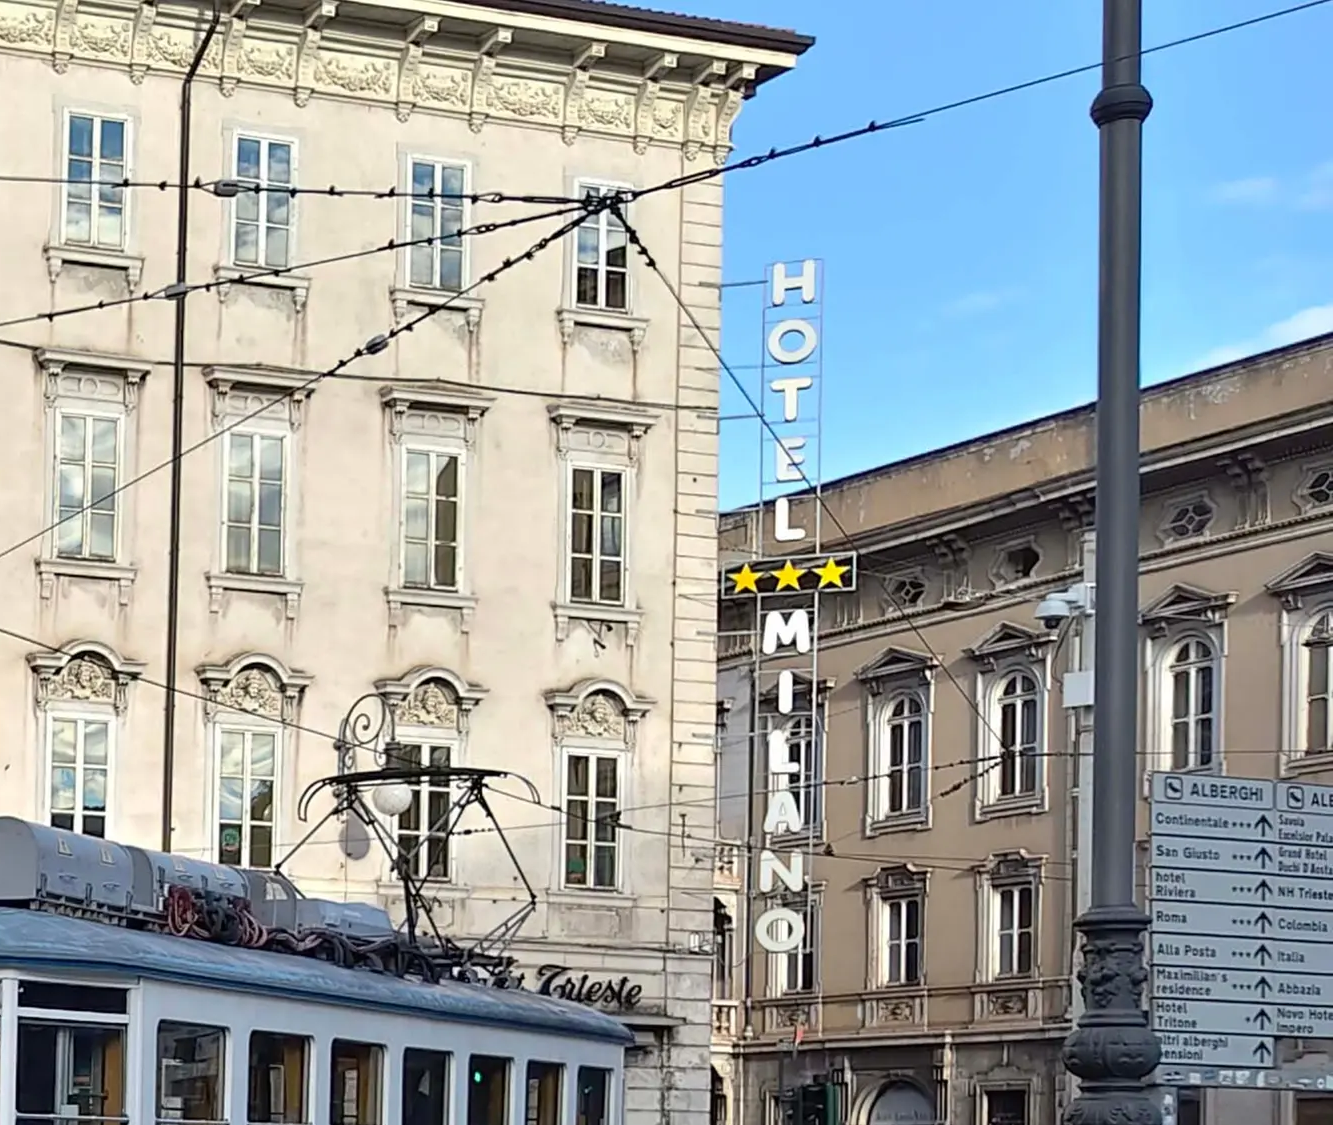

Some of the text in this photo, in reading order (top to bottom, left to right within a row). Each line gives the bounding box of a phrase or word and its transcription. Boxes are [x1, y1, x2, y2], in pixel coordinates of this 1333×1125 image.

[767, 259, 817, 542] HOTEL
[755, 608, 811, 953] MILANO
[1190, 783, 1264, 802] ALBERGHI
[1155, 811, 1230, 829] Continentale
[1279, 814, 1305, 827] Savoia
[1278, 828, 1313, 842] Excelsior
[1156, 845, 1221, 861] San Giusto
[1278, 846, 1327, 861] Grand Hotel
[1155, 872, 1186, 884] hotel
[1155, 885, 1197, 899] Riviera
[1277, 886, 1295, 897] NH
[1156, 910, 1188, 924] Roma
[1277, 918, 1329, 933] Colombia
[1157, 944, 1217, 958] Alla Posta
[1277, 951, 1305, 963] Italia
[536, 963, 643, 1010] Trieste
[1156, 983, 1212, 997] residence
[1277, 983, 1322, 996] Abbazia
[1155, 1002, 1188, 1014] Hotel
[1276, 1008, 1304, 1020] Novo
[1157, 1015, 1198, 1029] Tritone
[1276, 1022, 1315, 1034] Impero
[1182, 1035, 1229, 1050] alberghi
[1162, 1048, 1203, 1060] ensioni
